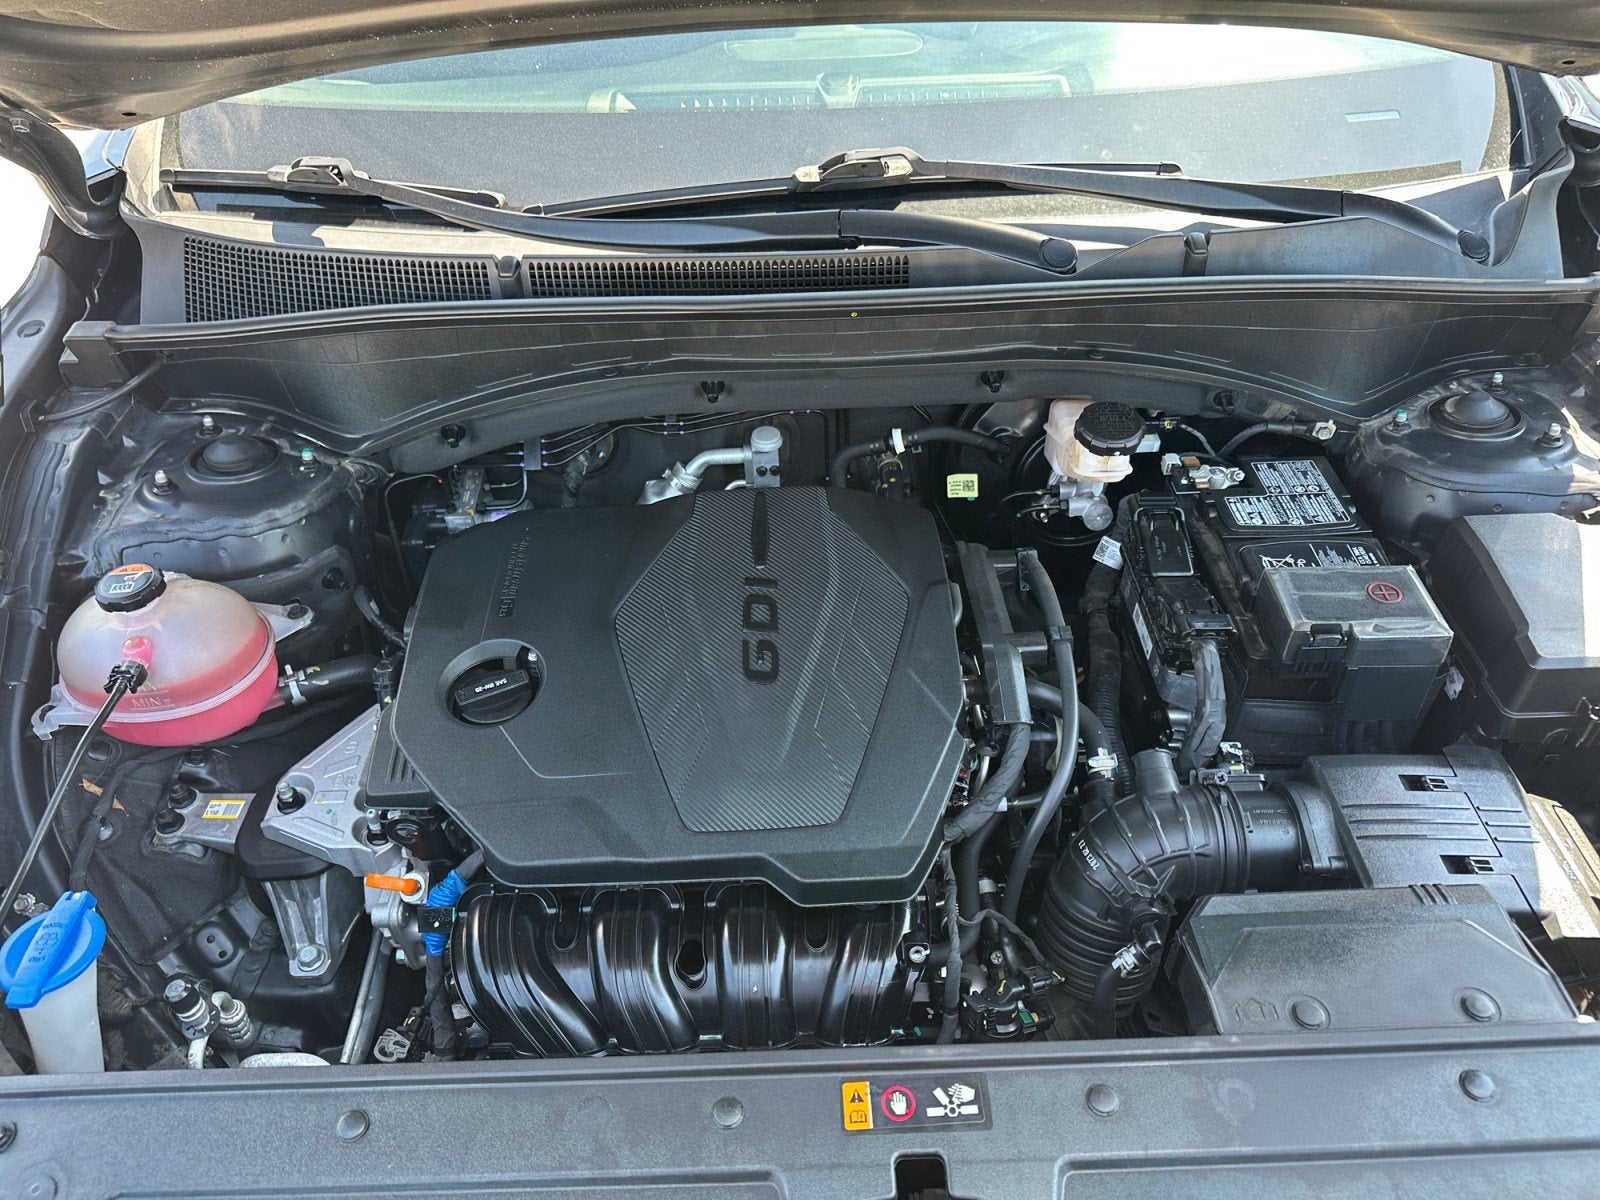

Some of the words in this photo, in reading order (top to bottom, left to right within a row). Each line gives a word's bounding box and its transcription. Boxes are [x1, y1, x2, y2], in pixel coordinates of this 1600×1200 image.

[742, 576, 780, 685] GDI
[474, 682, 495, 693] 0W-20
[495, 678, 507, 687] SAE
[131, 696, 161, 709] MIN
